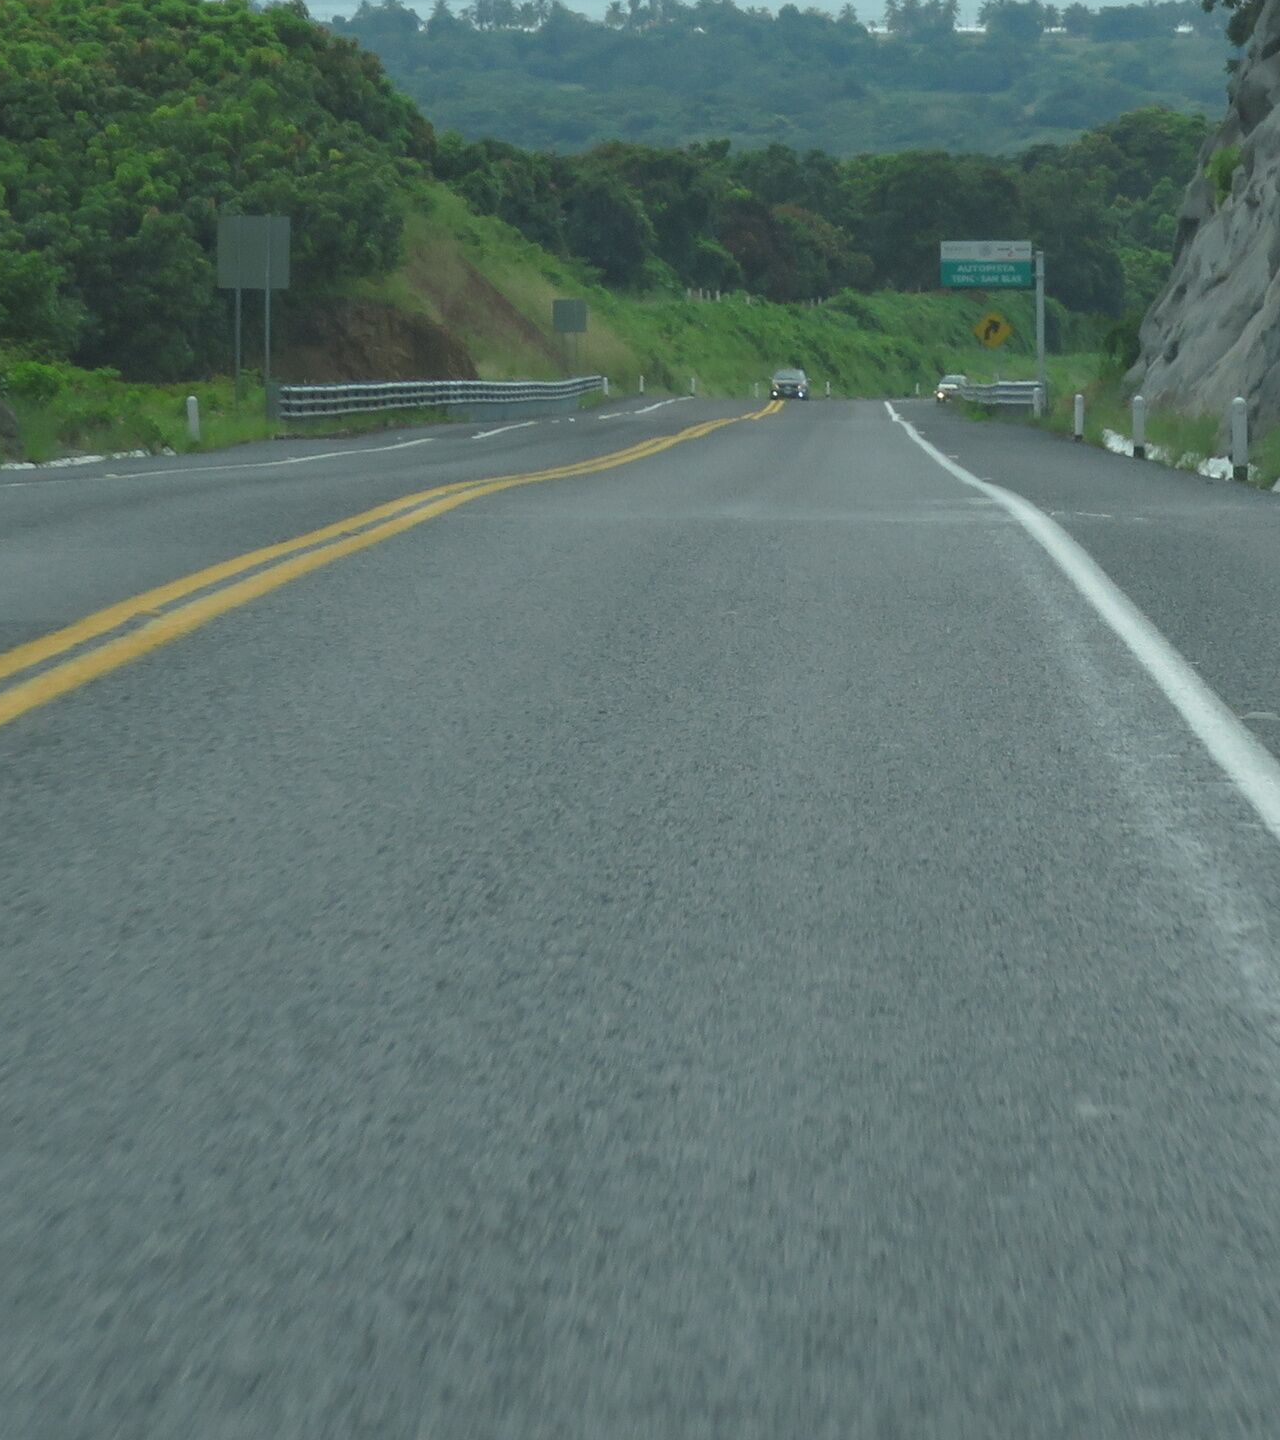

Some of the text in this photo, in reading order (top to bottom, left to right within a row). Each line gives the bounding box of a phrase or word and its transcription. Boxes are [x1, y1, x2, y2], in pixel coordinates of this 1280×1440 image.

[957, 265, 1015, 273] AUTOPISTA
[981, 275, 999, 283] SAN
[1001, 275, 1022, 283] BLAS
